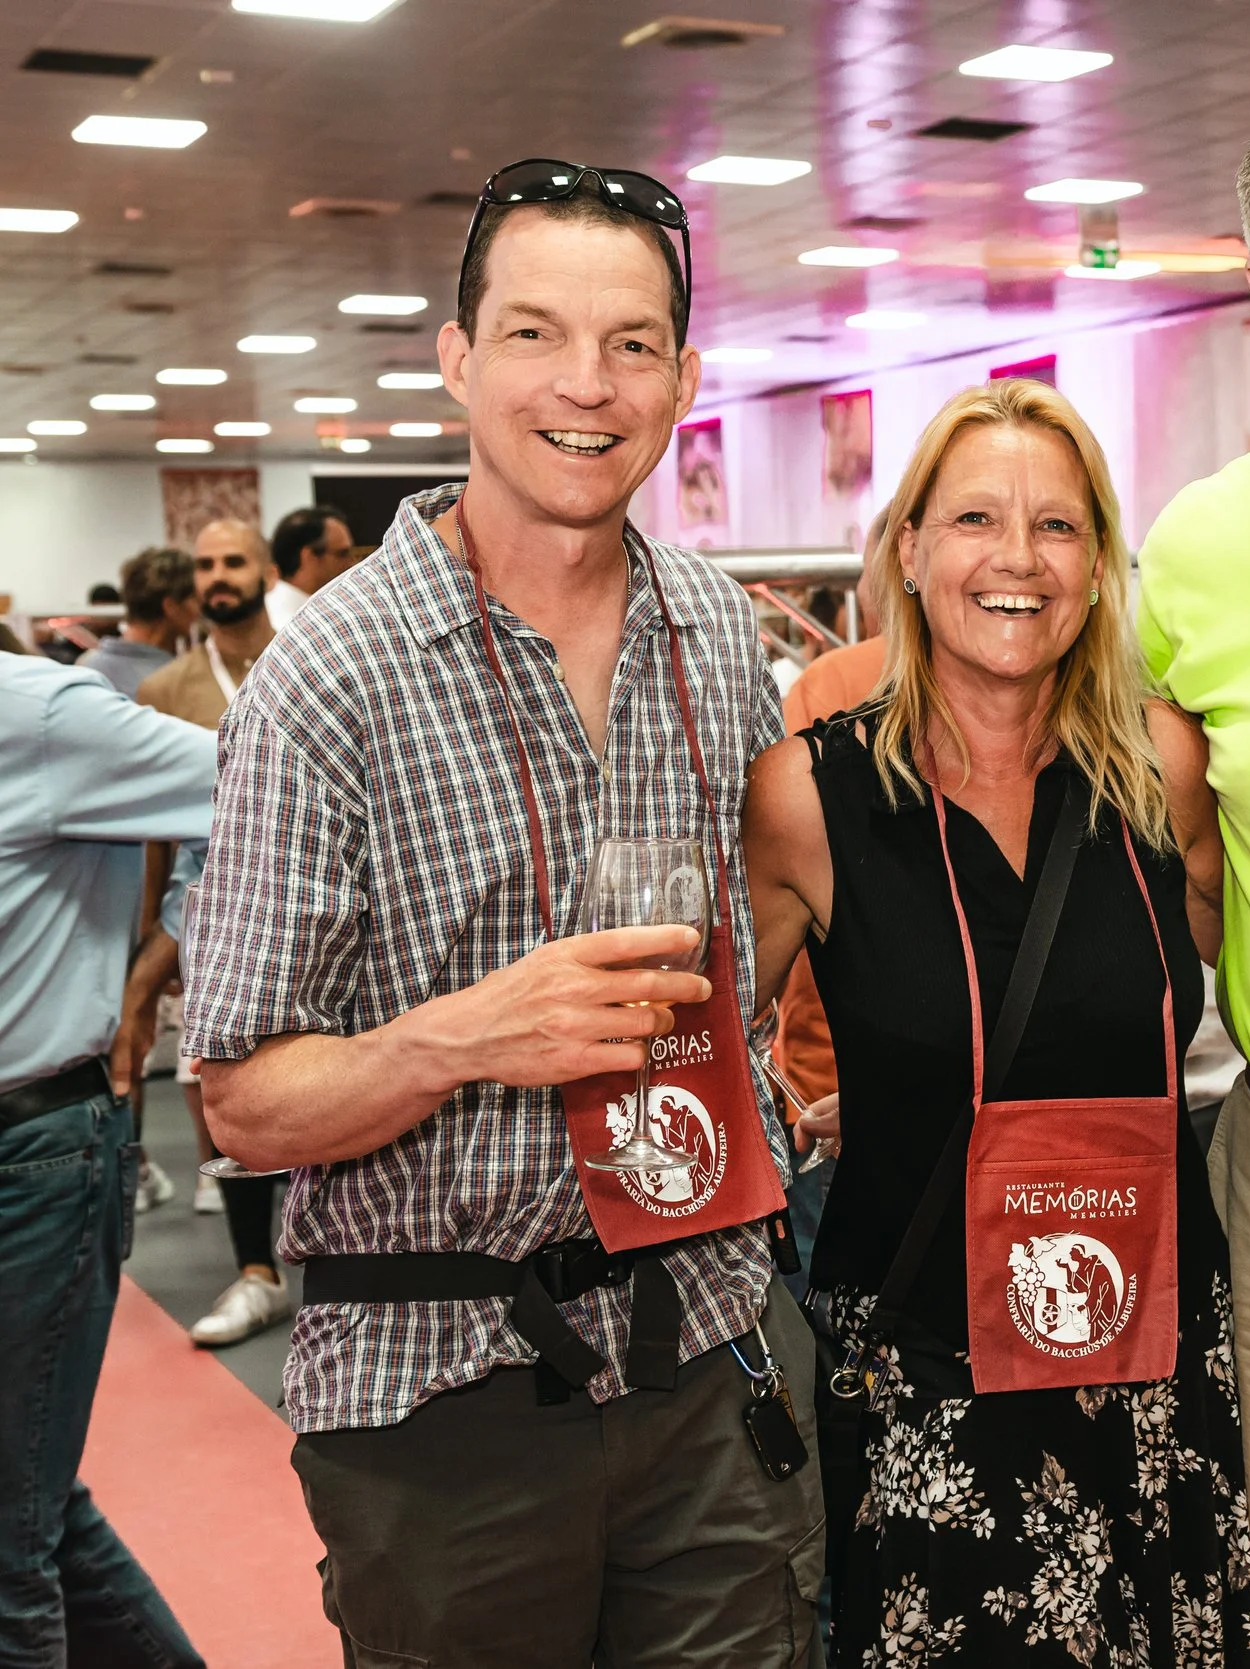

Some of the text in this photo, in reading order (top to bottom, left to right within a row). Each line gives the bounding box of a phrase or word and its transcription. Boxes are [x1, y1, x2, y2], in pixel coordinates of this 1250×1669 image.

[650, 1030, 712, 1062] ÓRIAS
[655, 1053, 714, 1071] MEMORIES
[616, 1121, 728, 1218] FRARIA DO BACCHUS DE ALBUFEIRA
[1004, 1185, 1138, 1215] MEMÓRIAS
[1005, 1182, 1066, 1191] RESTAURANTE
[1070, 1210, 1138, 1220] MEMORIES
[1006, 1273, 1138, 1359] CONFRARIA DO BACCHUS DE ALBUFEIRA
